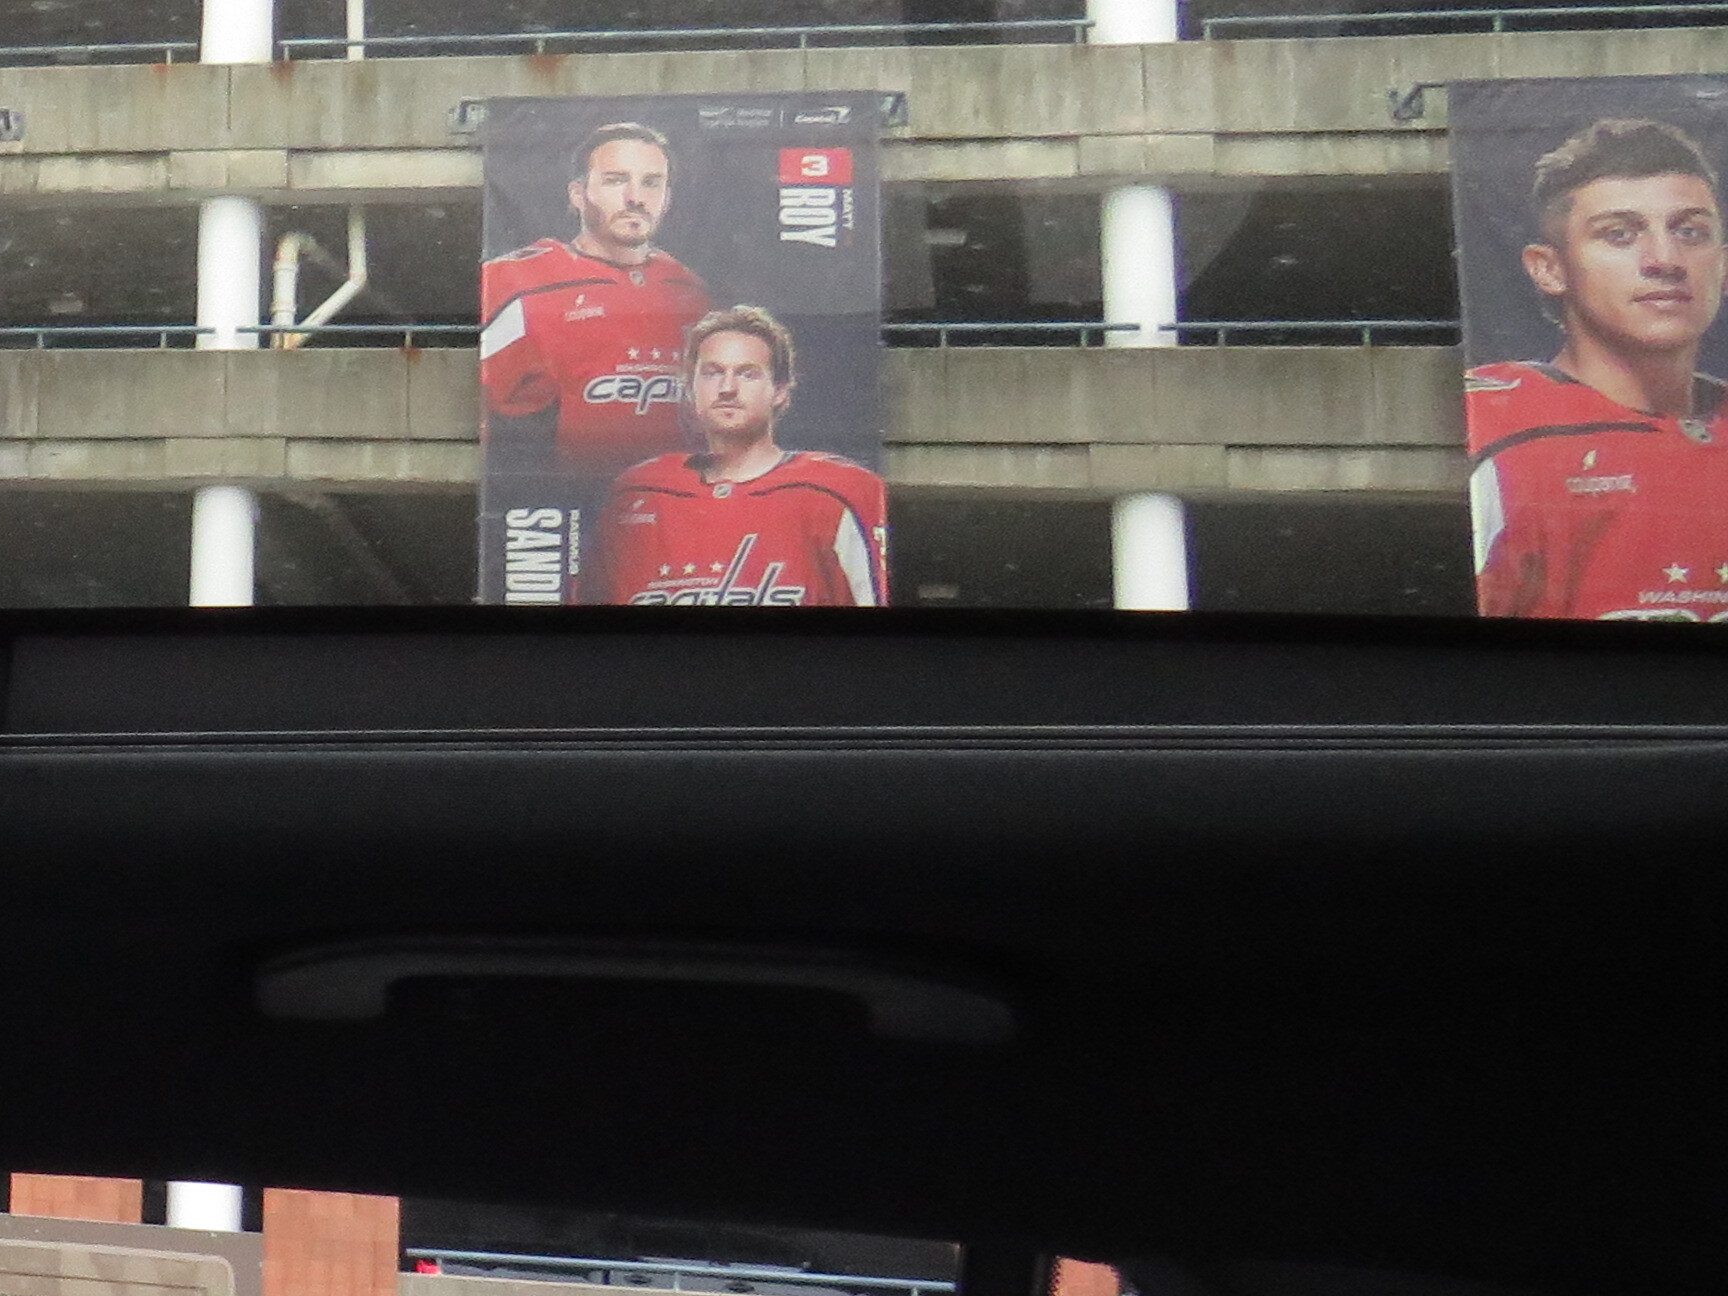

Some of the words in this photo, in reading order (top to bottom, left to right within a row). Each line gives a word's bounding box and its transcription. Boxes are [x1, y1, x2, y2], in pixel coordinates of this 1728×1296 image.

[800, 155, 829, 177] 3
[778, 188, 837, 248] ROY
[505, 507, 562, 605] SANDI
